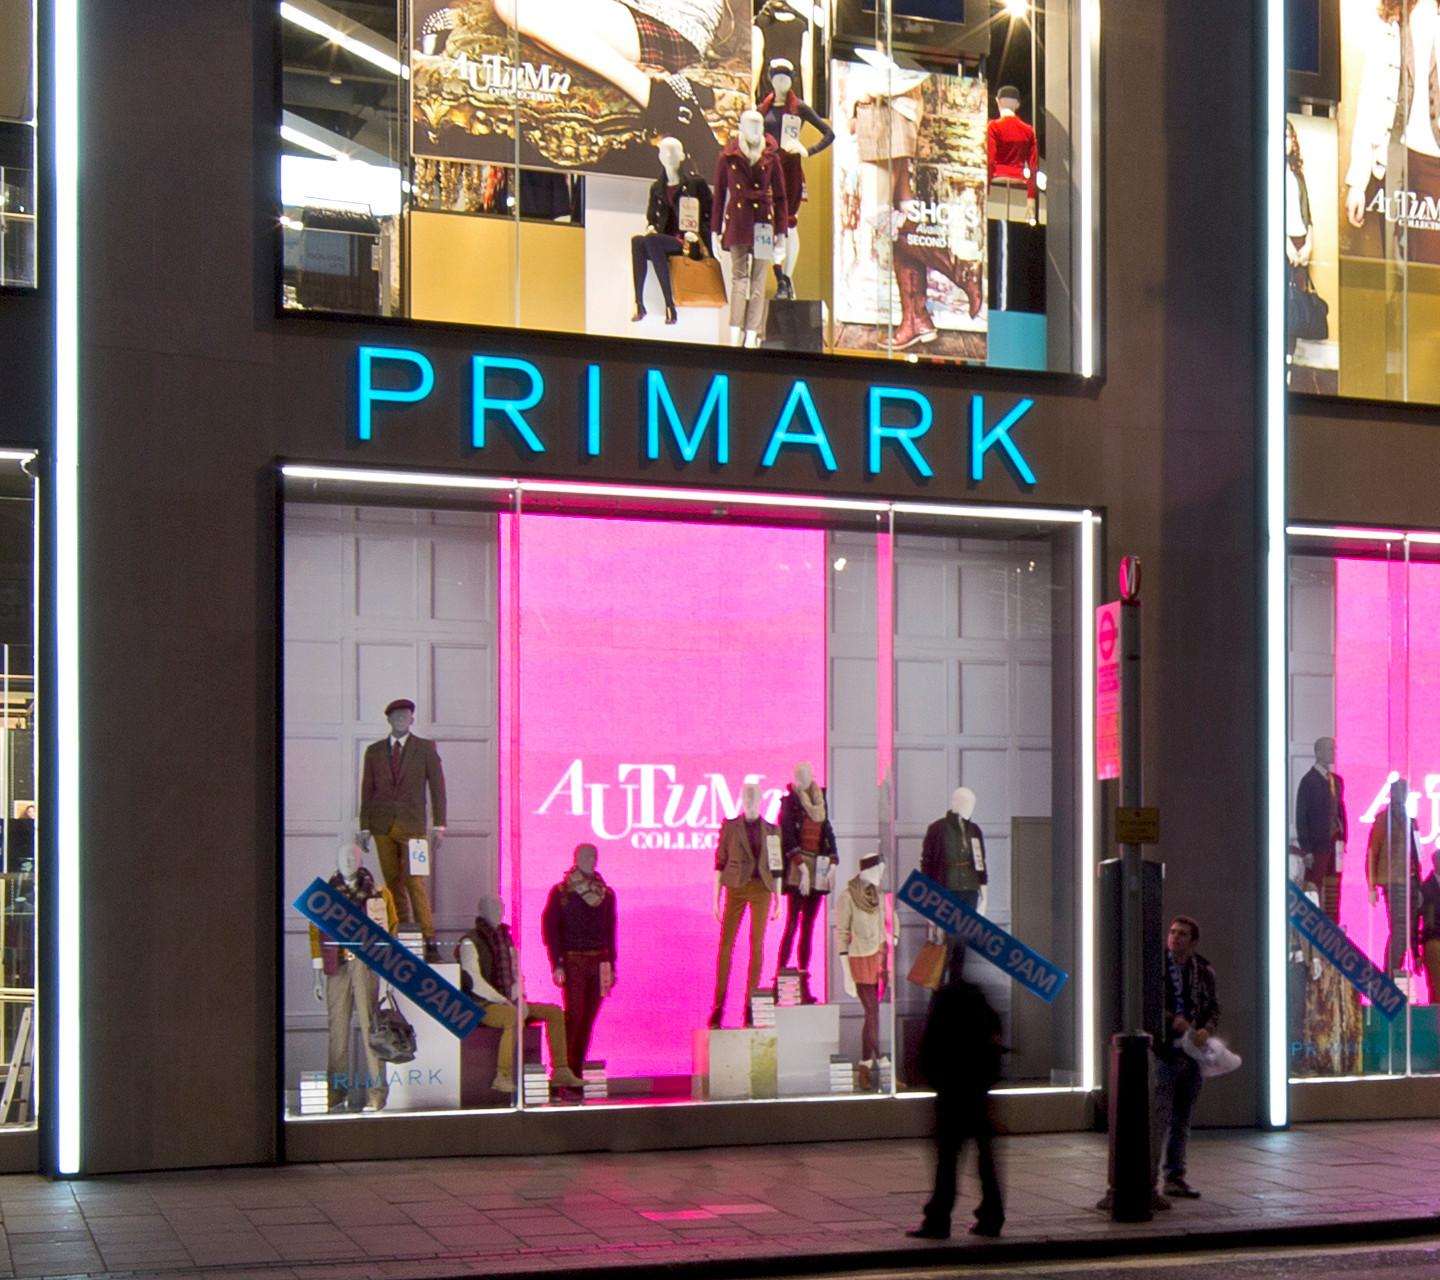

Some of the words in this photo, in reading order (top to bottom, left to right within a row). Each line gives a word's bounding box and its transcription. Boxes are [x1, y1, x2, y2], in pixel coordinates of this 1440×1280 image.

[906, 199, 979, 228] SHOS
[359, 345, 1038, 485] PRIMARK
[630, 830, 720, 851] COLLEC
[306, 889, 418, 984] OPENING
[415, 977, 476, 1030] 9AM
[907, 879, 1006, 957] OPENING
[1006, 948, 1058, 994] 9AM
[1358, 966, 1402, 1014] 9AM
